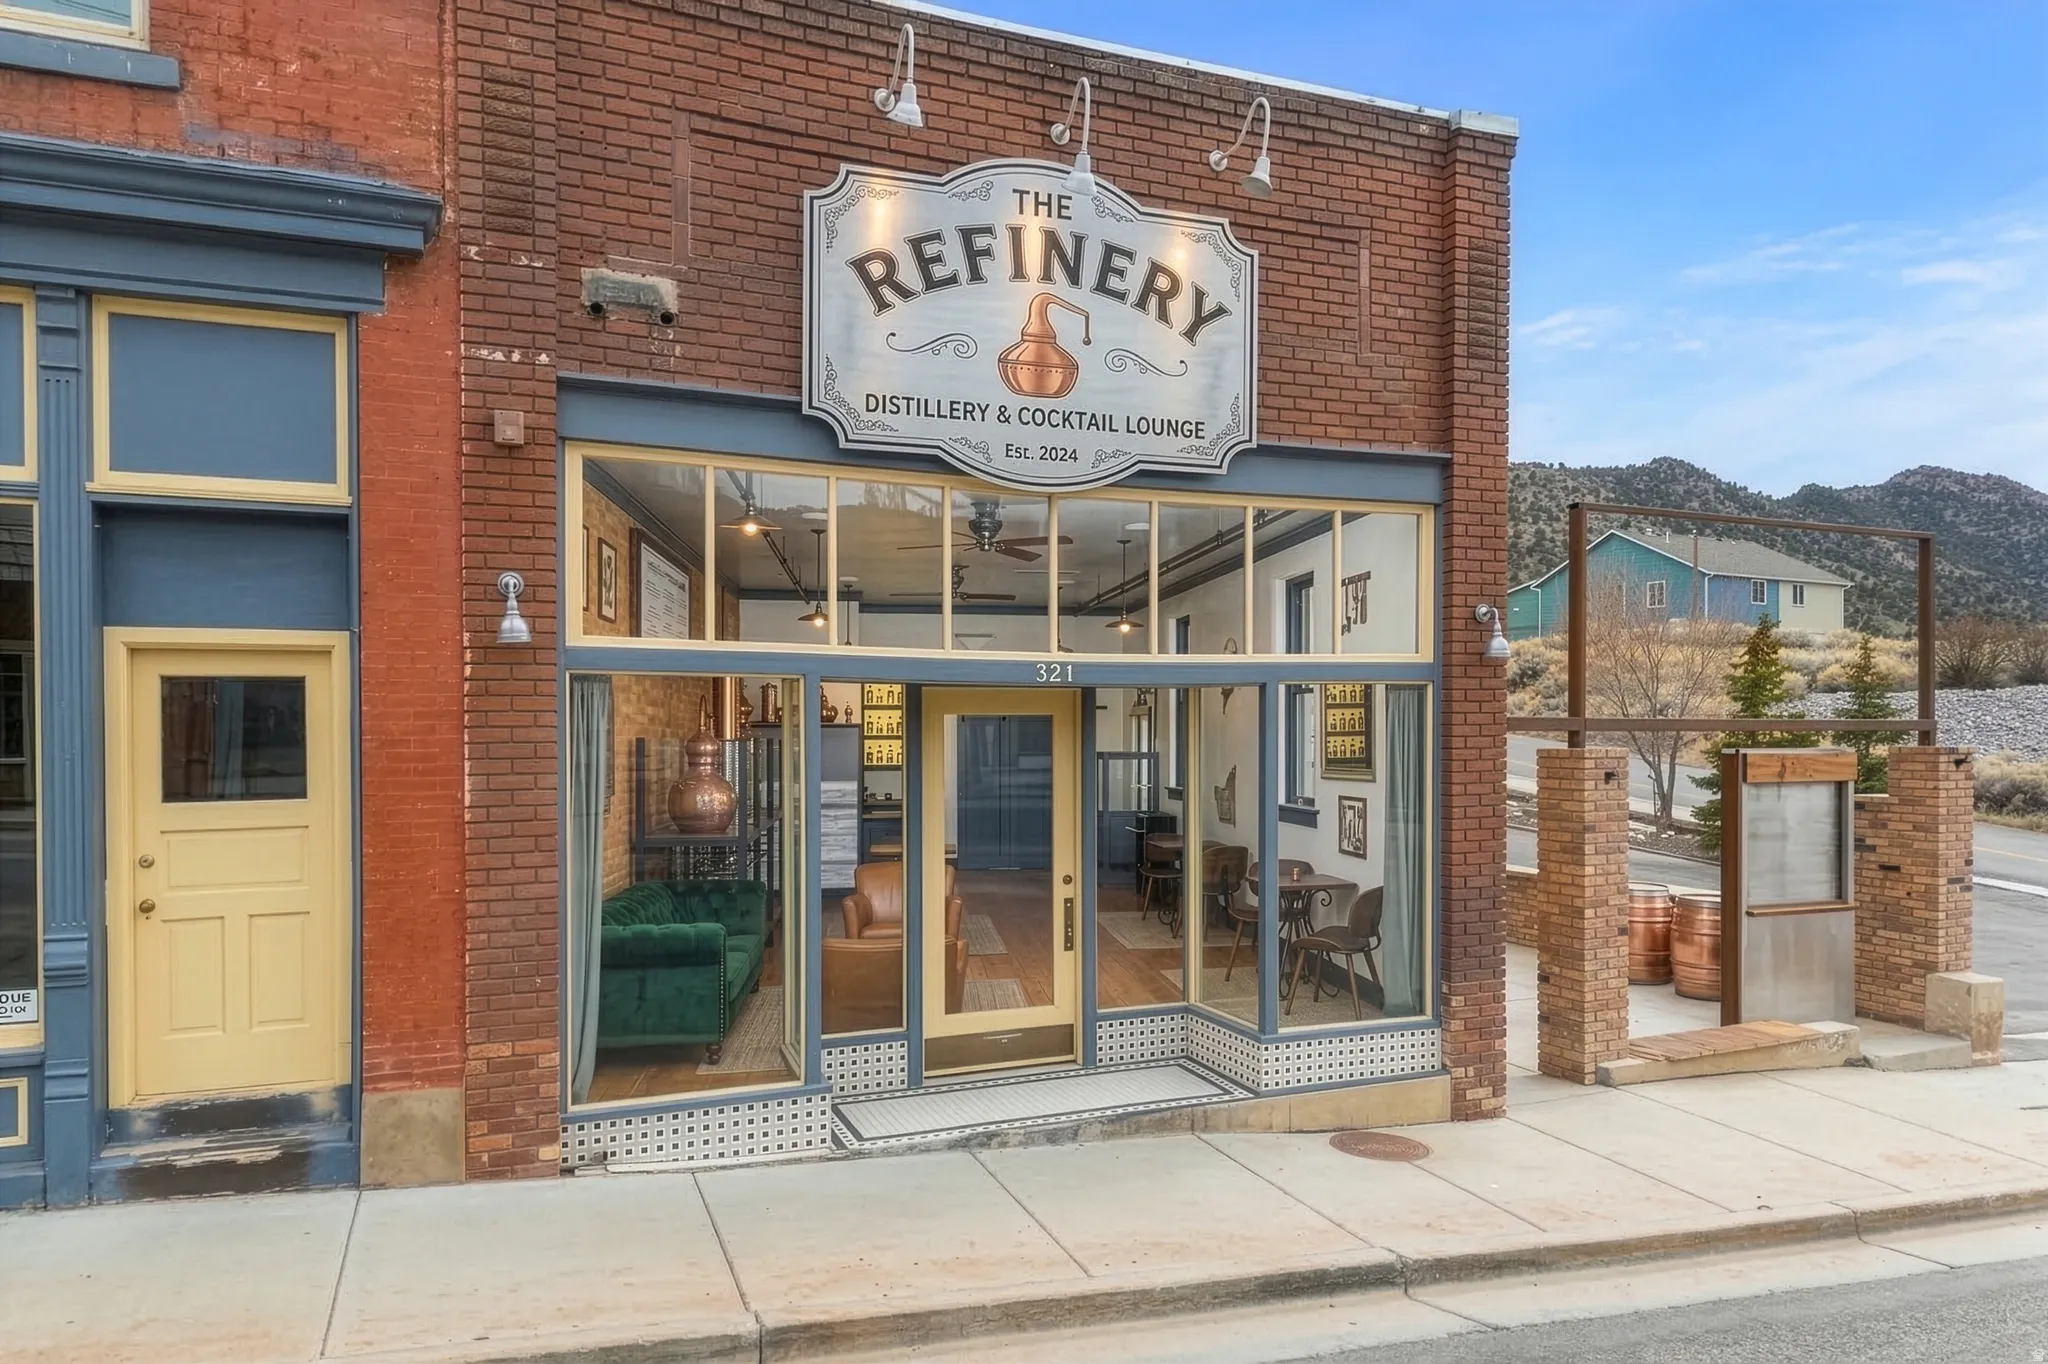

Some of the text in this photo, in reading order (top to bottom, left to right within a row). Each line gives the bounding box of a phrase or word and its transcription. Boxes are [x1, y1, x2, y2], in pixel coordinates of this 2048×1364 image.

[1012, 188, 1073, 220] THE
[846, 223, 1232, 347] REFINERY
[865, 393, 1205, 440] DISTILLERY & COCKTAIL LOUNGE
[1039, 445, 1079, 463] 2024
[1036, 663, 1073, 682] 321
